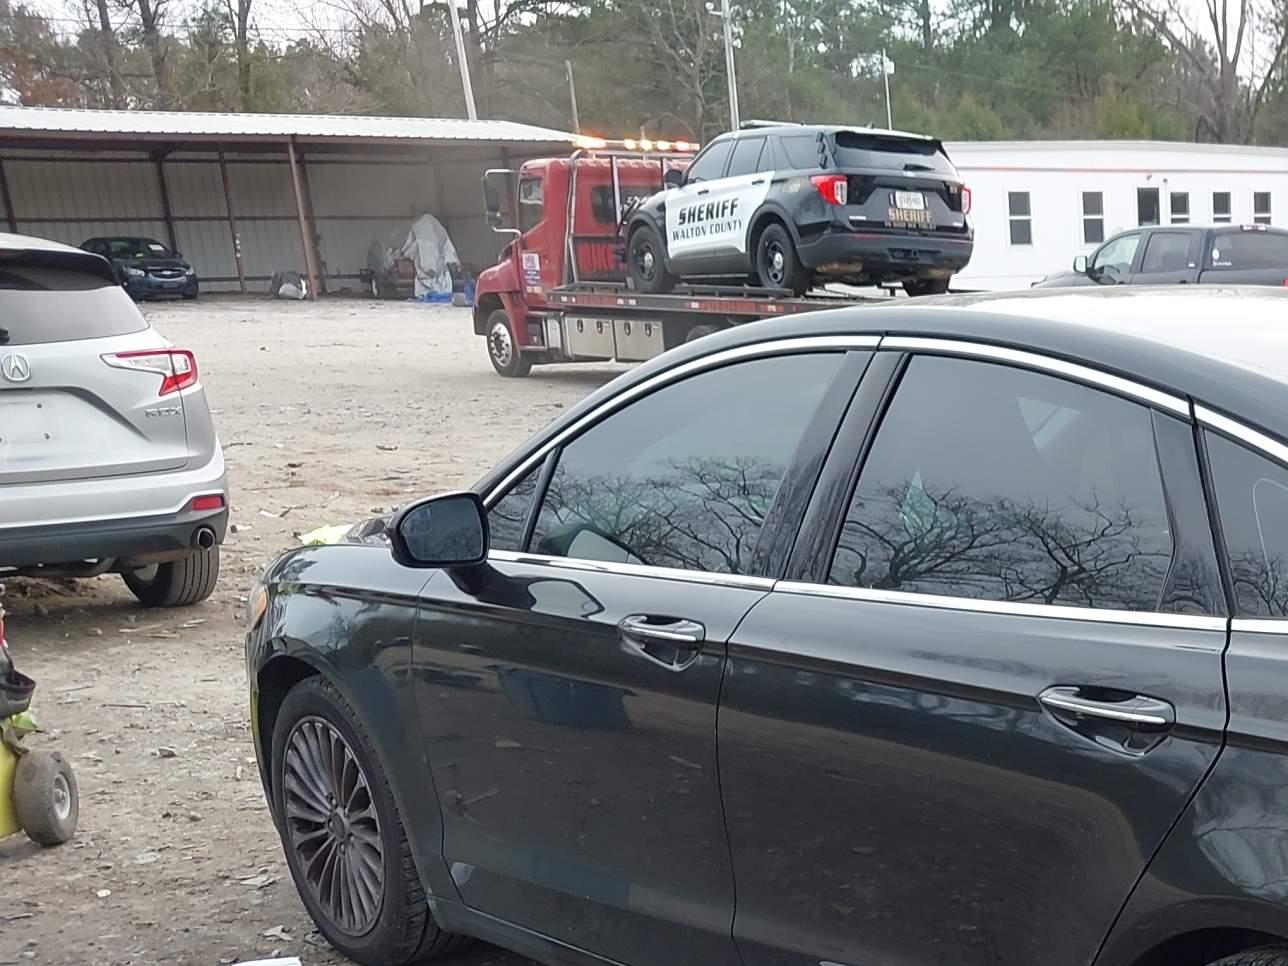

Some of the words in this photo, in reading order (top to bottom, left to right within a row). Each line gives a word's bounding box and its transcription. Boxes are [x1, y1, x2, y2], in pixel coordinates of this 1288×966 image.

[678, 197, 739, 226] SHERIFF
[888, 208, 933, 223] SHERIFF
[672, 225, 706, 241] WALTON
[709, 217, 743, 235] COUNTY
